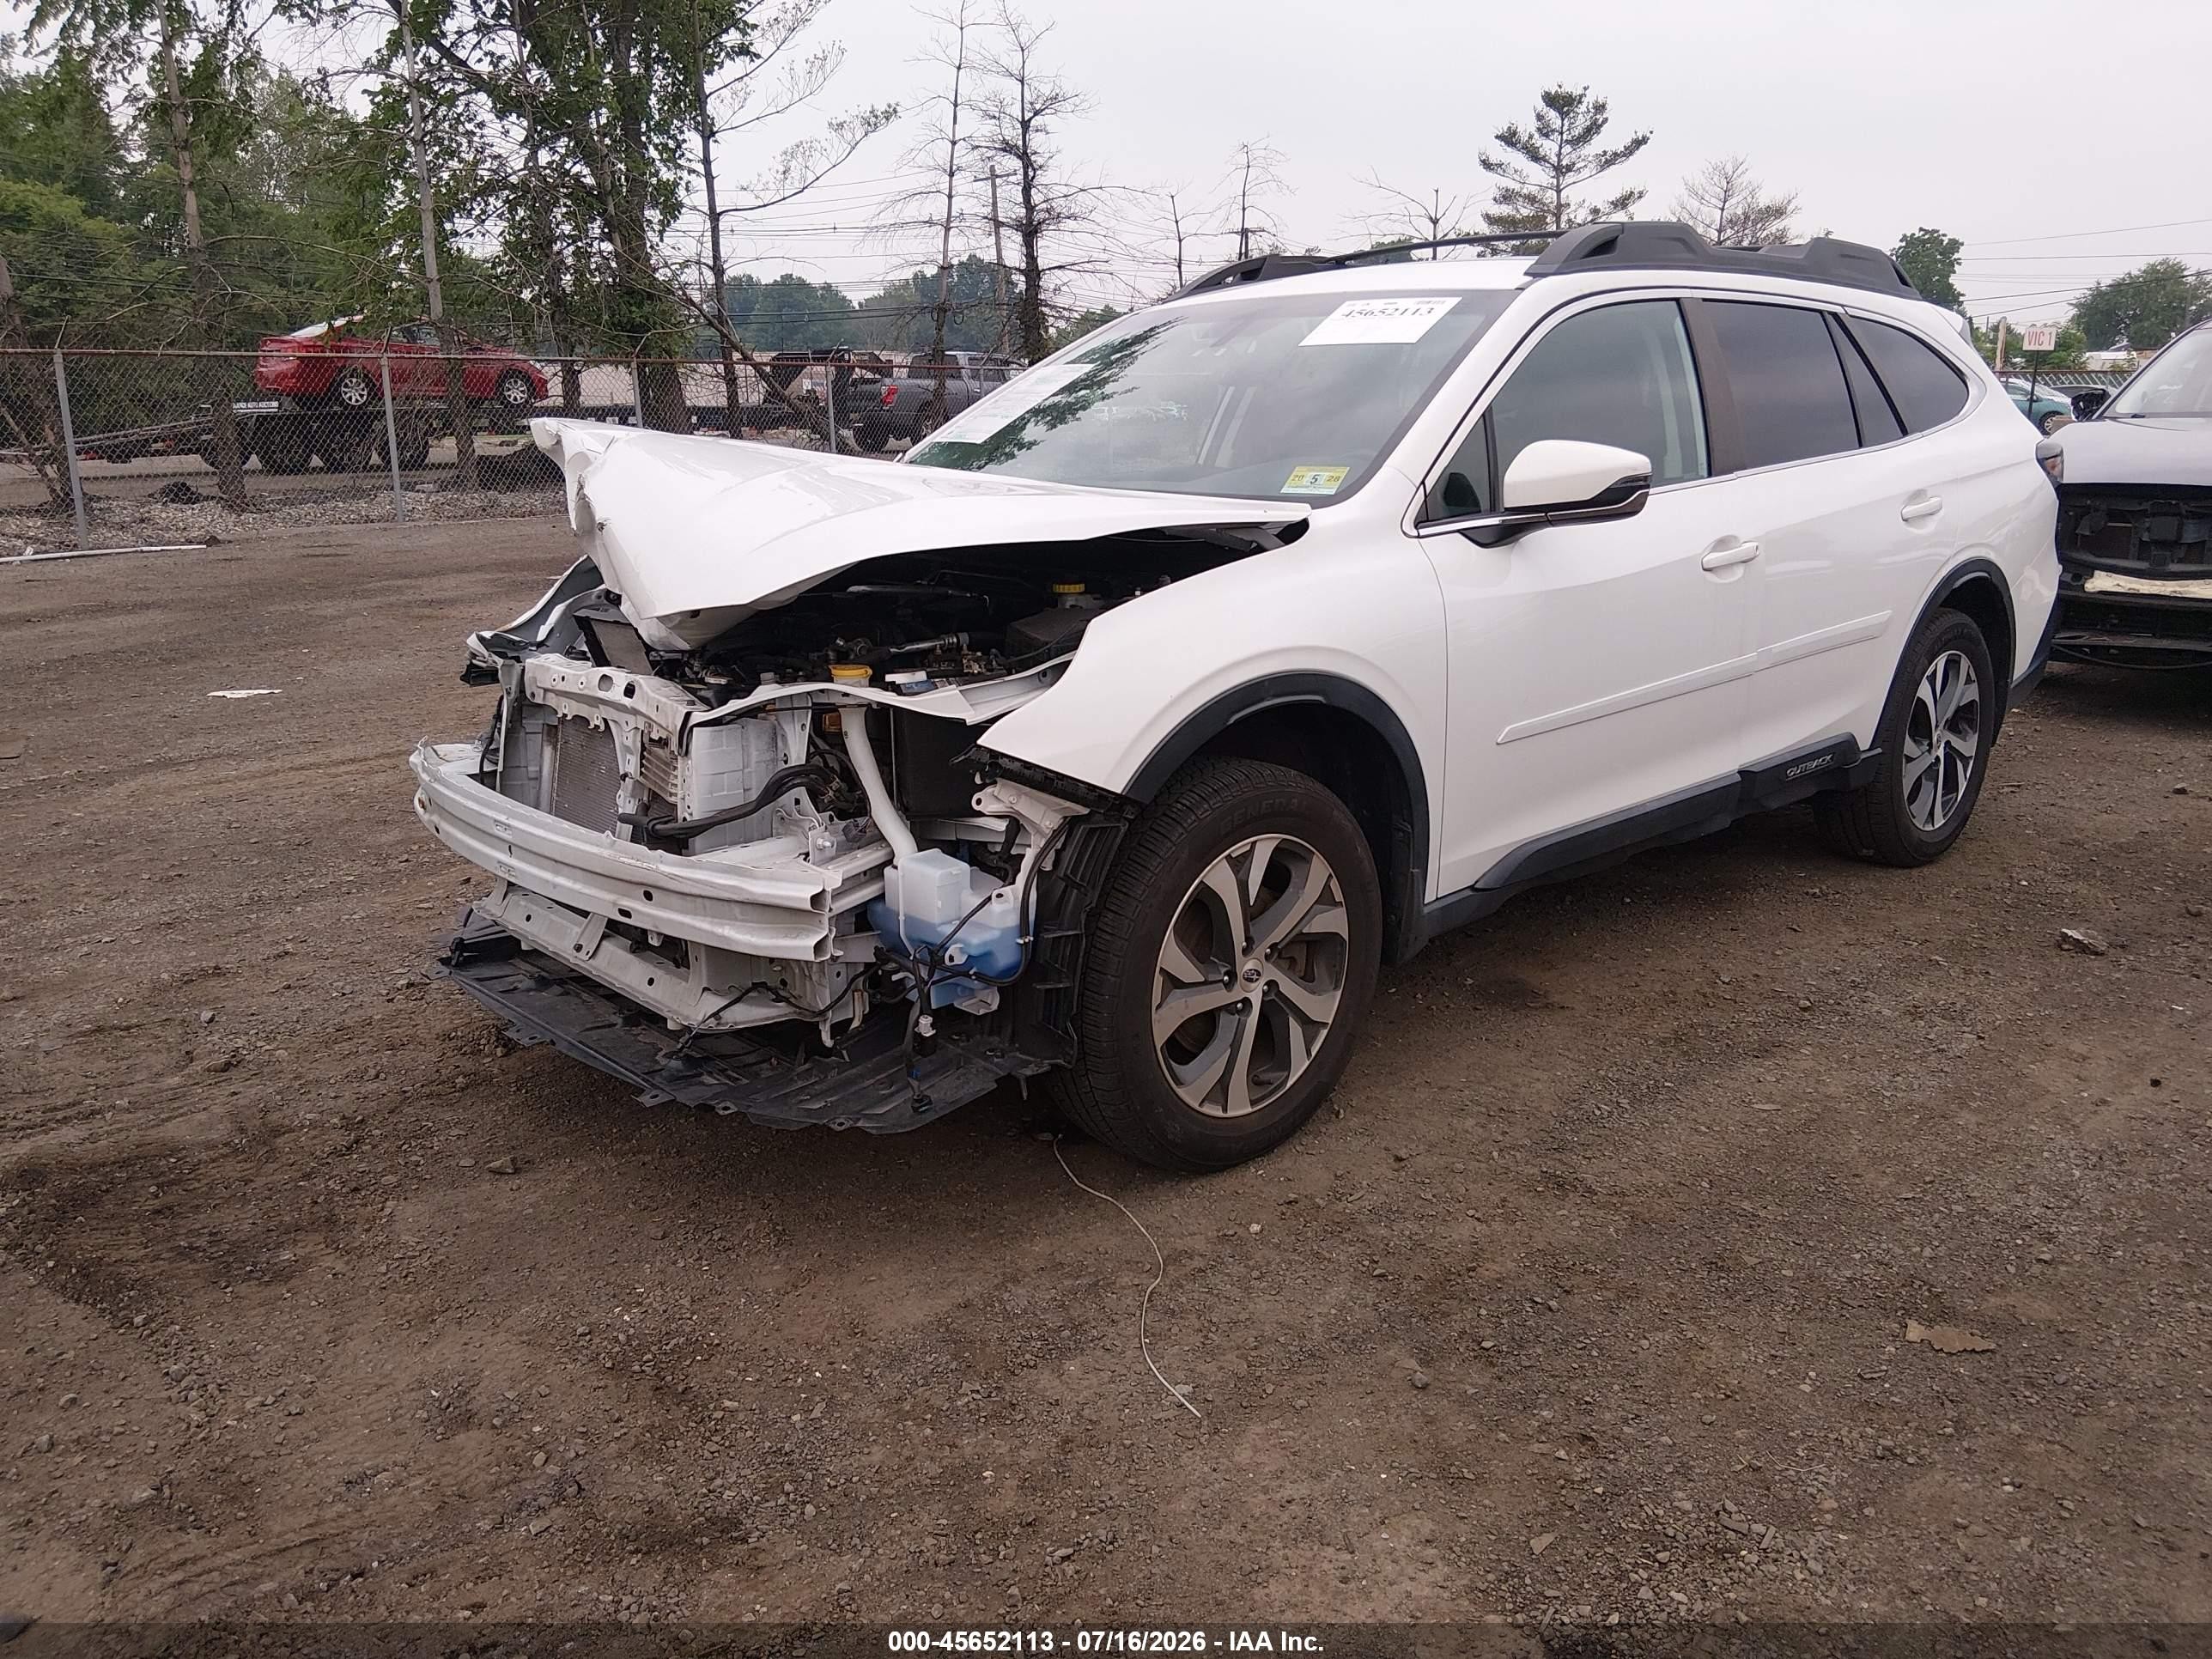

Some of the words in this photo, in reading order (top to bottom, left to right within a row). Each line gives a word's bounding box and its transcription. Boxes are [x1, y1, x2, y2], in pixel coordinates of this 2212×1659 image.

[1341, 307, 1435, 318] 45652113
[2027, 331, 2045, 346] VIC
[2048, 331, 2053, 346] 1
[1310, 474, 1320, 484] 5
[1786, 754, 1833, 776] OUTBACK
